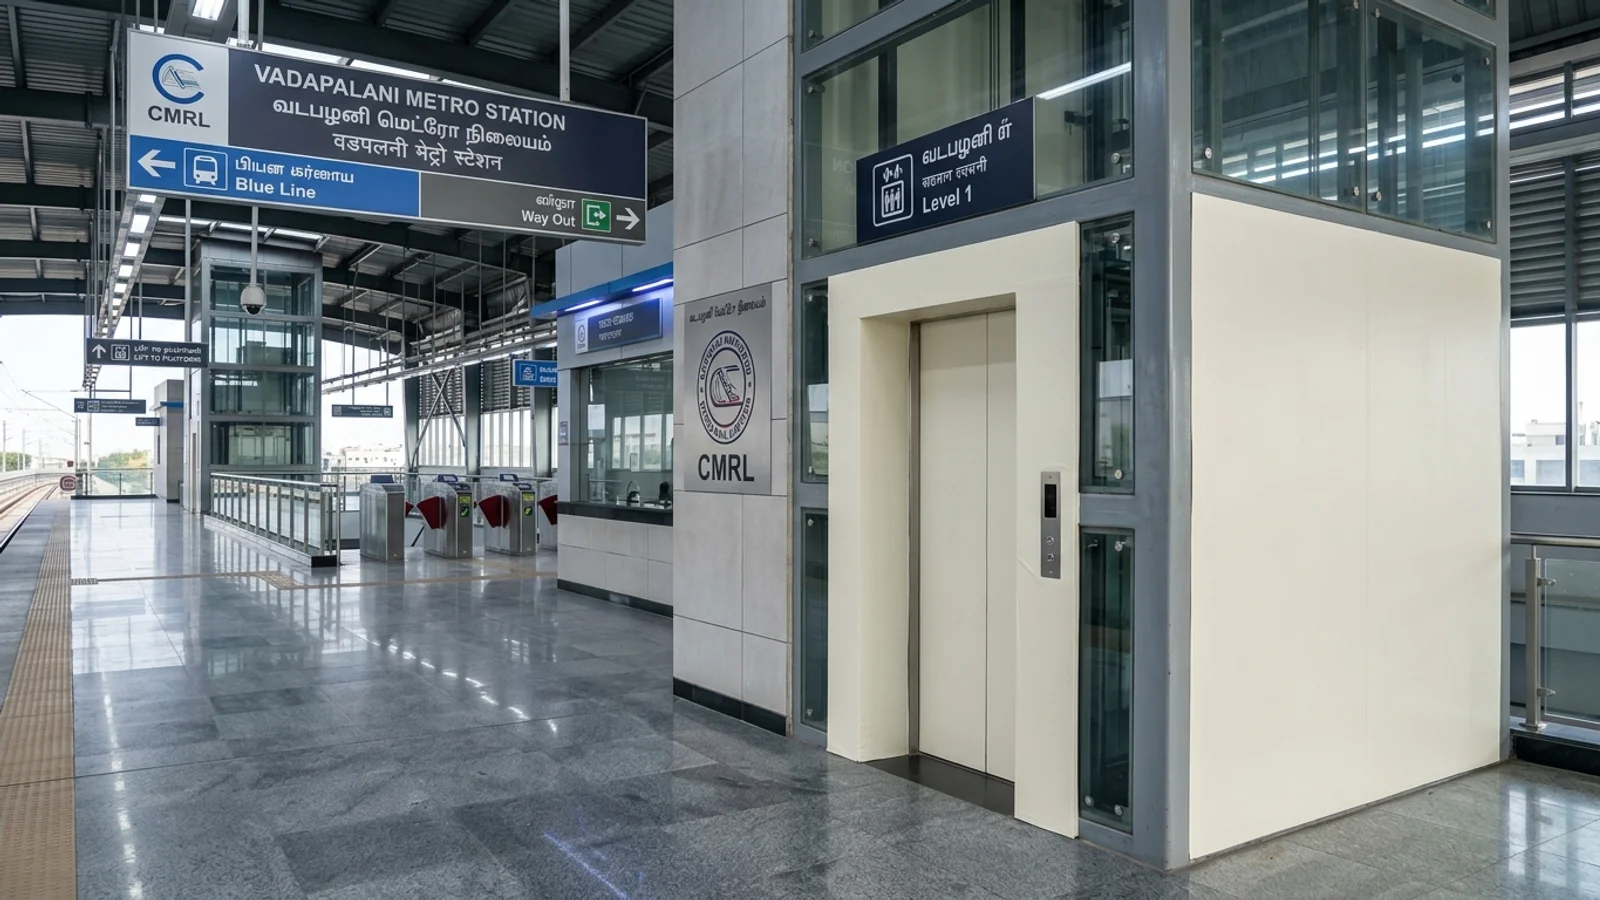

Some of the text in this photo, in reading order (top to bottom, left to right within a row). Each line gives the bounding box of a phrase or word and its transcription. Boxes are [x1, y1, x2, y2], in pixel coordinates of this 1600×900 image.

[254, 64, 566, 132] VADAPALANI METRO STATION
[148, 105, 211, 128] CMRL
[273, 99, 552, 152] வடபழனி மெட்ரோ நிலையம்
[332, 133, 409, 158] वडपलनी
[453, 148, 503, 171] स्टेशन
[235, 176, 317, 199] Blue Line
[923, 184, 972, 214] Level 1
[521, 209, 576, 228] Way Out
[698, 453, 755, 482] CMRL
